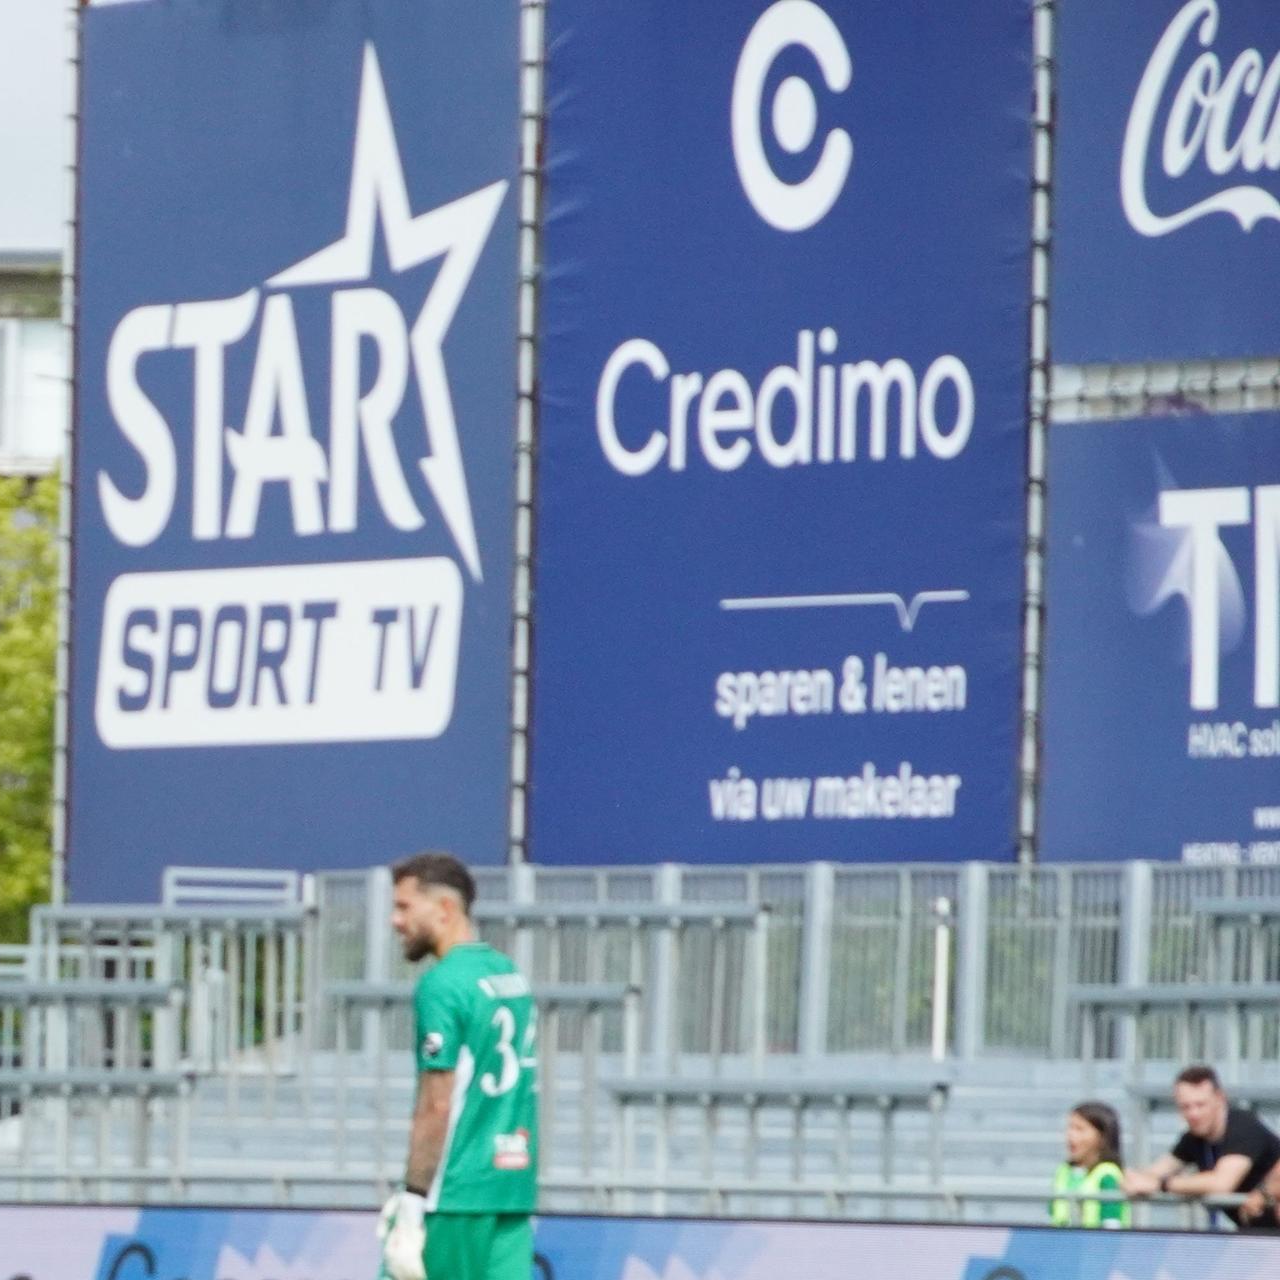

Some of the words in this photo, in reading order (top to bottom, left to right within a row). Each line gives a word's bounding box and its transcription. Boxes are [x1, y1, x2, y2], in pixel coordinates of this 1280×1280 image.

[98, 286, 426, 547] STAR
[597, 327, 974, 476] Credimo
[117, 600, 338, 713] SPORT
[372, 603, 440, 692] TV
[715, 660, 835, 731] sparen
[840, 654, 867, 714] &
[871, 651, 967, 713] lenen
[1188, 720, 1248, 759] HVAC
[709, 765, 757, 821] via
[761, 776, 811, 821] uw
[813, 760, 962, 820] makelaar
